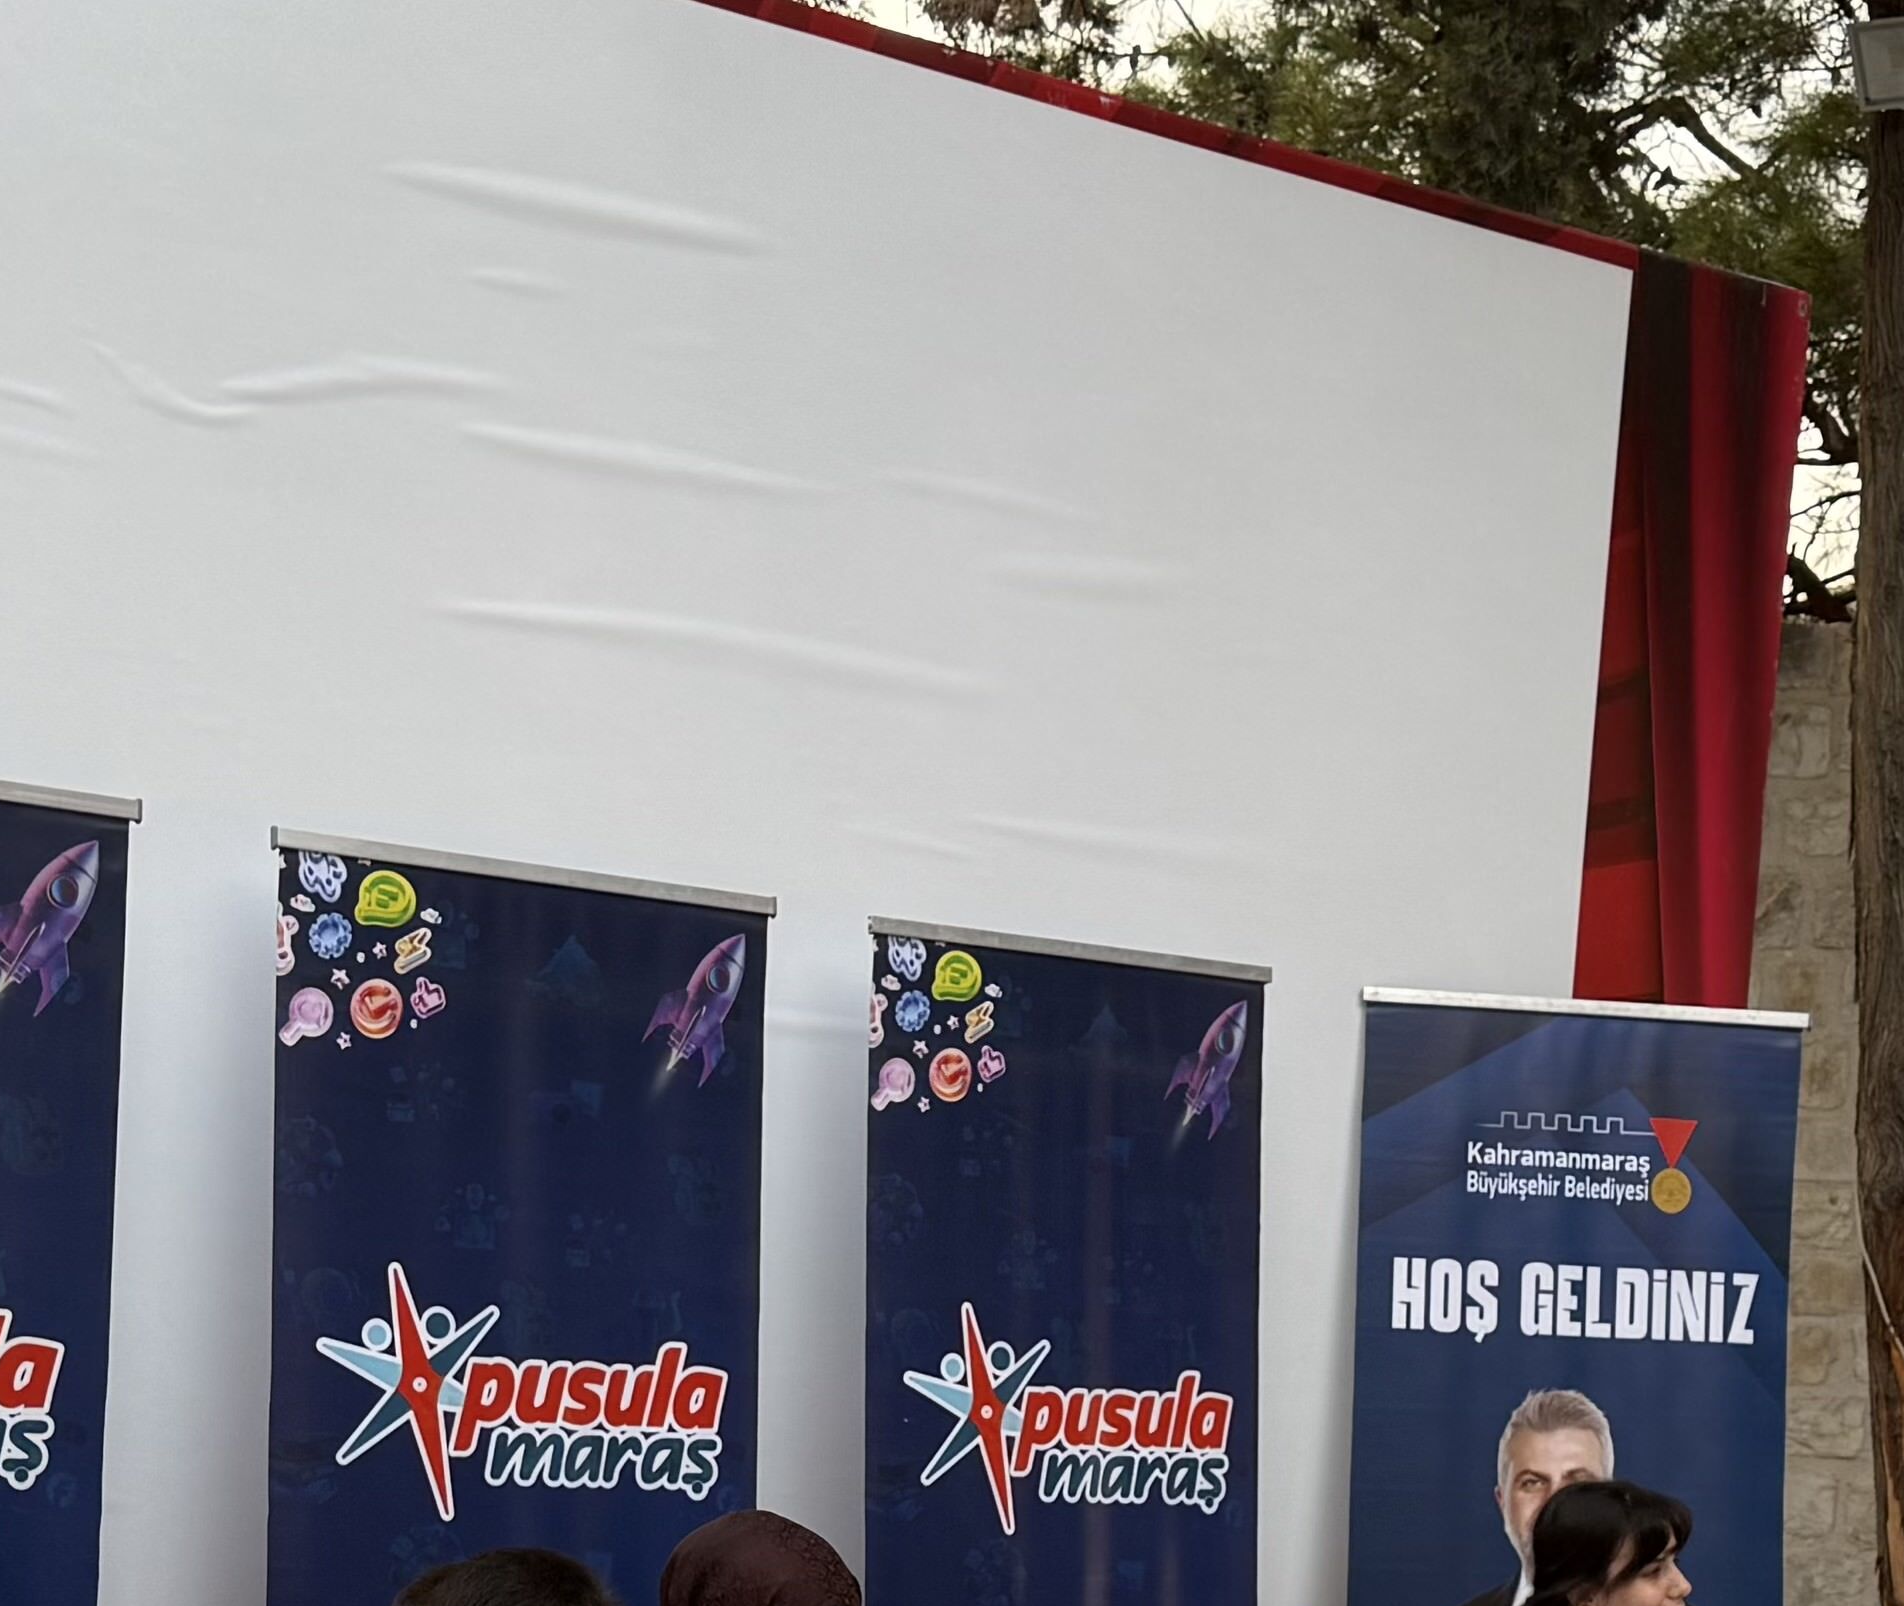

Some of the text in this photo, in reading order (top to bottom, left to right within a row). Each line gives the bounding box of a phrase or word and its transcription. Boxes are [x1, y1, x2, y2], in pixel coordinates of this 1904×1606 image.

[1467, 1141, 1650, 1178] Kahramanmaraş
[1467, 1171, 1649, 1205] Büyükşehir Belediyesi
[1391, 1257, 1498, 1343] HOŞ
[450, 1341, 728, 1457] pusula
[1011, 1370, 1233, 1476] pusula
[485, 1426, 722, 1500] maraş
[1039, 1450, 1229, 1514] maraş
